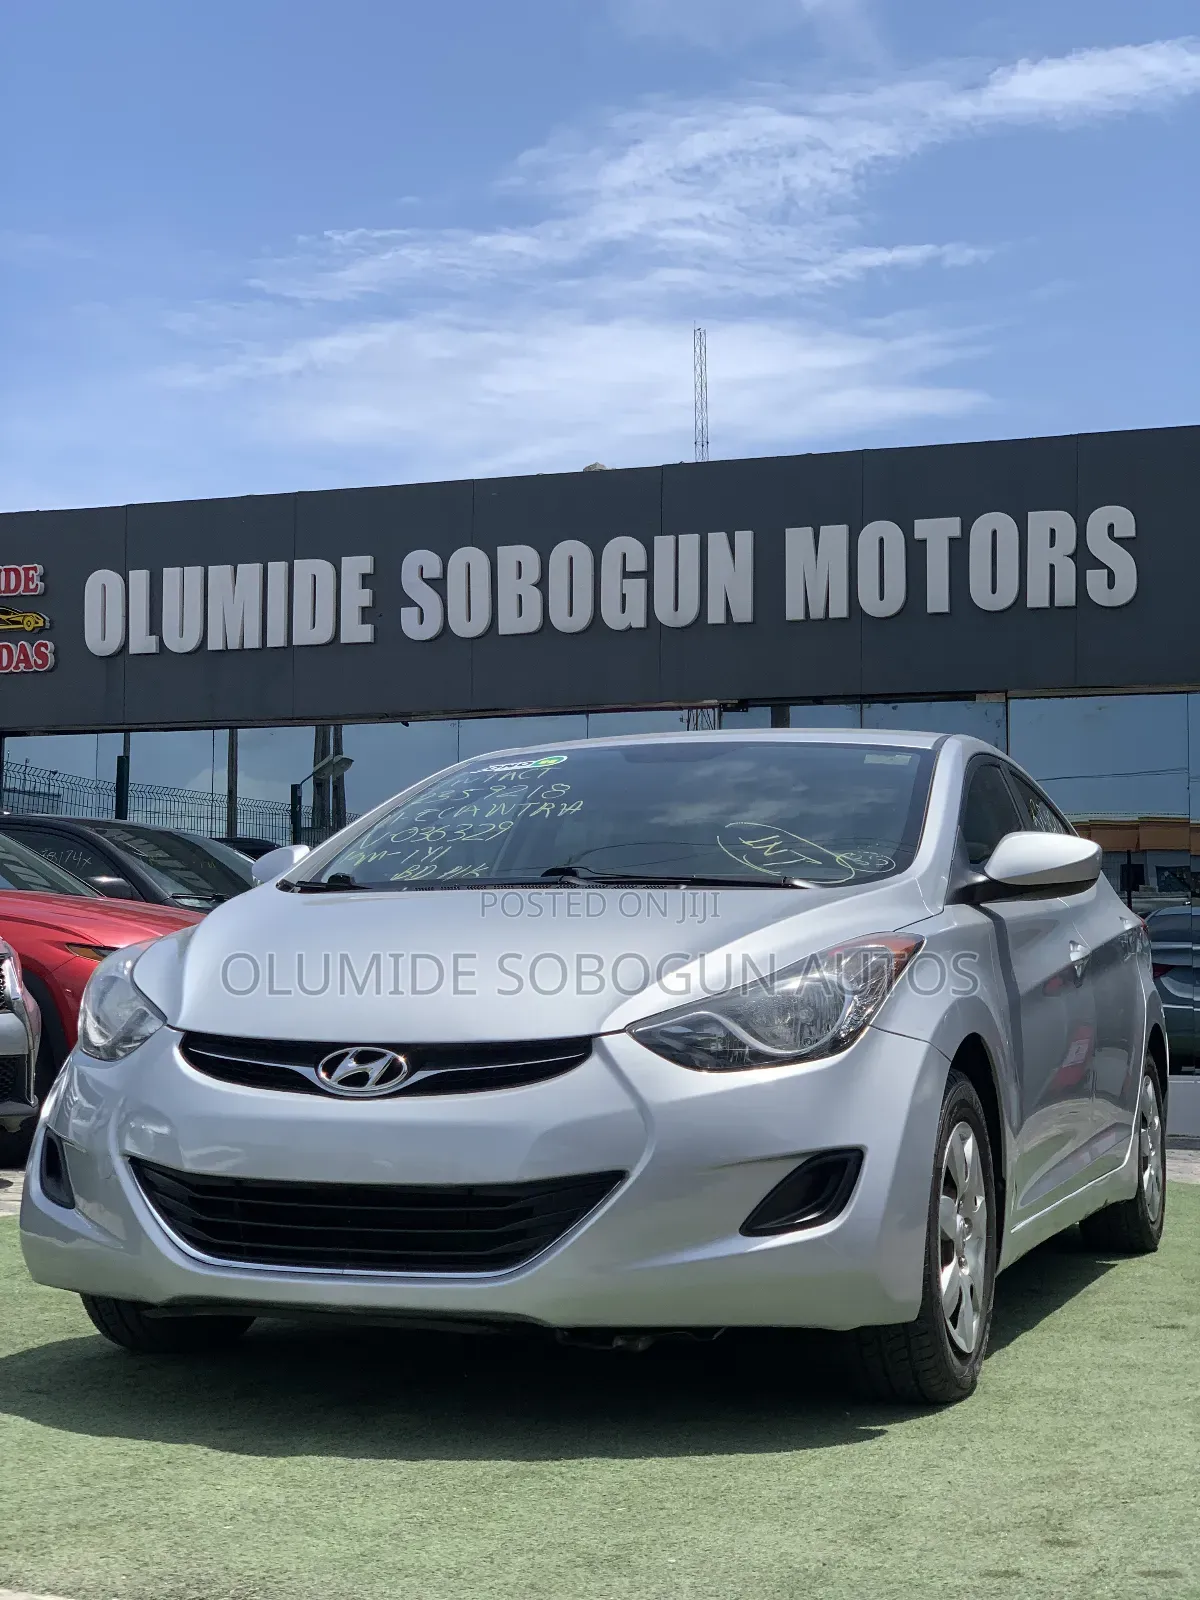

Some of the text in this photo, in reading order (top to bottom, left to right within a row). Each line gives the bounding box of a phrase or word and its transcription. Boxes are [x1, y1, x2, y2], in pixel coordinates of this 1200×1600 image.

[0, 564, 44, 596] DE
[84, 505, 1138, 657] OLUMIDE SOBOGUN MOTORS
